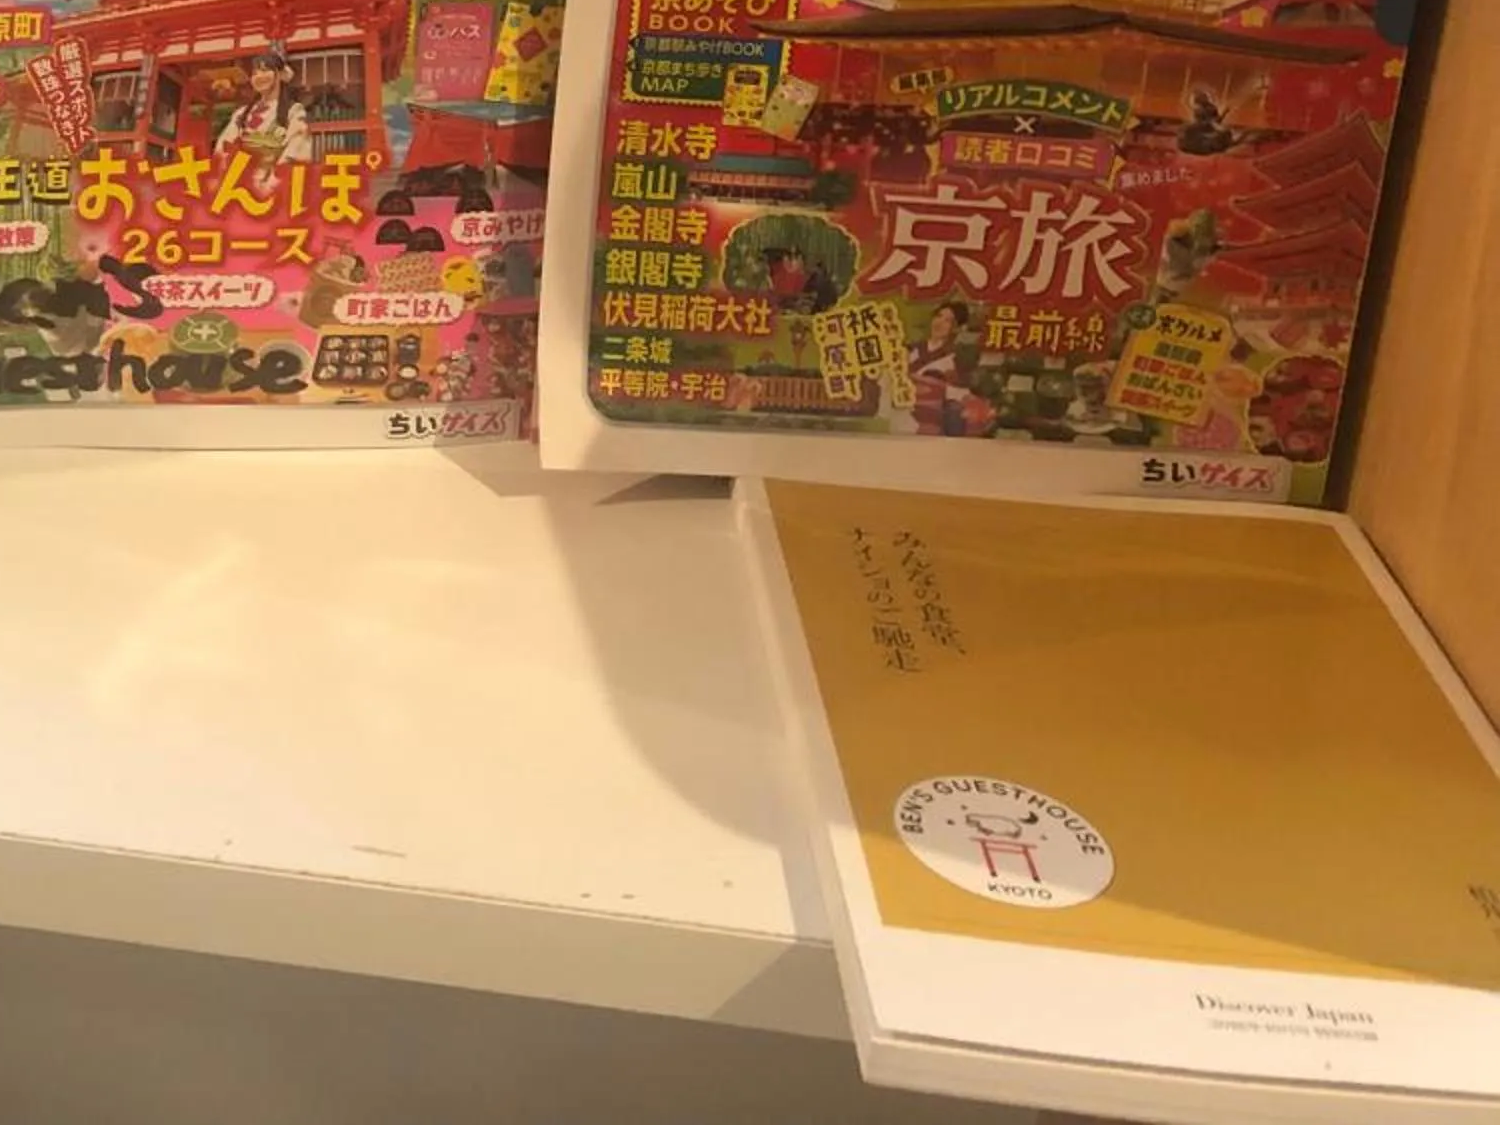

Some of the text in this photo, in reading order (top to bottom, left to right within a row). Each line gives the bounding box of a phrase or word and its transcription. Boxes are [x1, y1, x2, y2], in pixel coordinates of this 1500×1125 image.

[649, 14, 735, 35] BOOK
[640, 76, 690, 93] MAP
[945, 85, 1123, 125] リアルコメント
[616, 118, 718, 161] 清水寺
[954, 139, 1099, 169] 読者口コミ
[77, 145, 384, 223] おさんぽ
[611, 162, 677, 201] 嵐山
[610, 204, 708, 245] 金閣寺
[868, 184, 1136, 298] 京旅
[120, 227, 313, 265] 26コース
[605, 248, 704, 289] 銀閣寺
[346, 296, 455, 320] 町家ごはん
[602, 290, 772, 336] 伏見稲荷大社
[985, 305, 1106, 353] 最前線
[388, 411, 508, 439] ちいサイズ
[1142, 458, 1274, 489] ちいサイズ
[900, 777, 1106, 856] BEN'S GUESTHOUSE
[987, 881, 1053, 901] KYOTO
